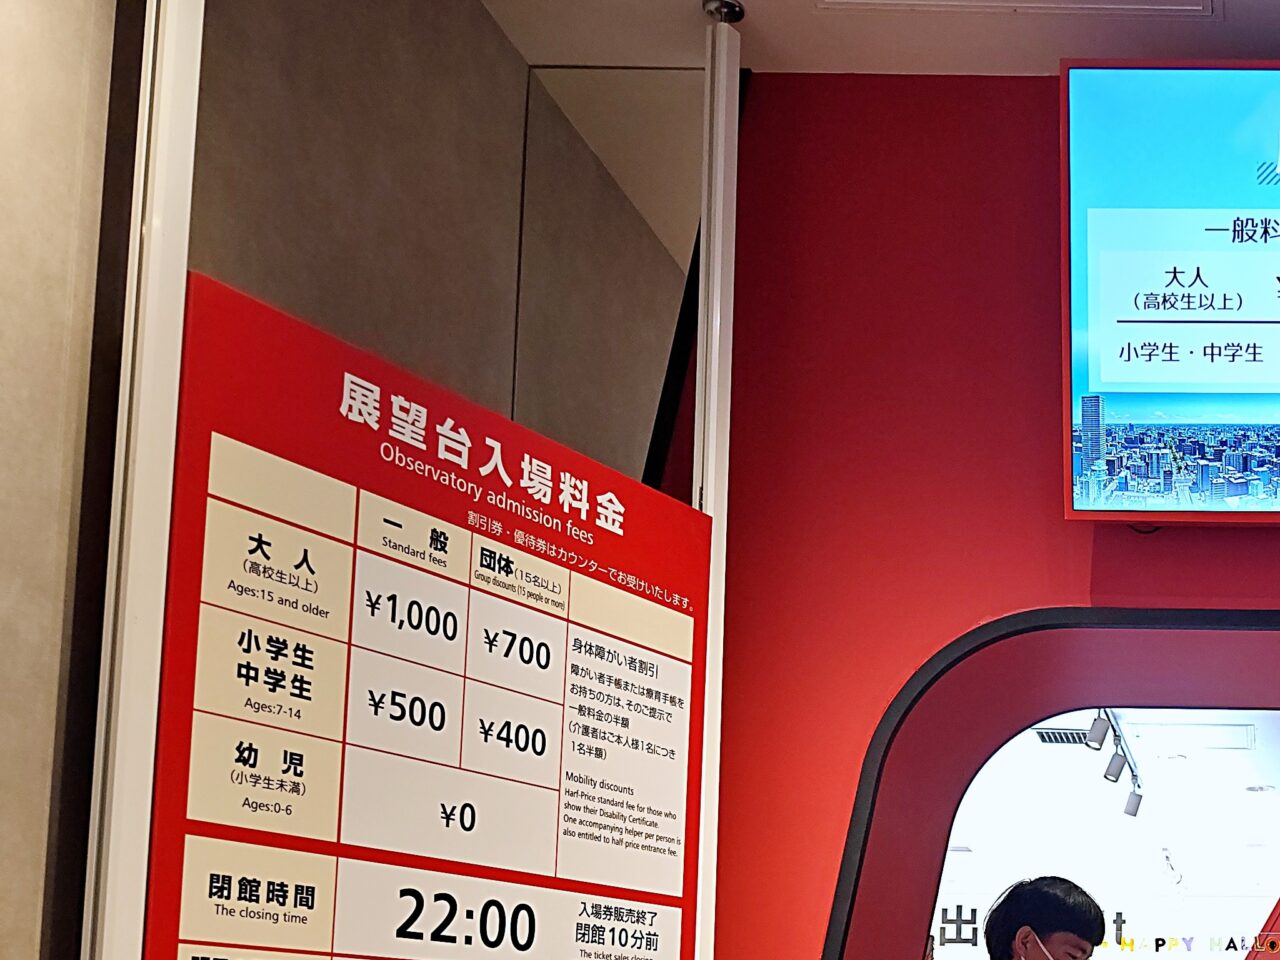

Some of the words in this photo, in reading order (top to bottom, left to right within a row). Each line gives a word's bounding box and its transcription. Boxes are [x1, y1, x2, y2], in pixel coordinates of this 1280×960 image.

[1164, 266, 1209, 289] 大人
[1119, 342, 1264, 363] 小学生・中学生
[339, 371, 625, 536] 展望台入場料金
[379, 441, 483, 502] Observatory
[487, 486, 562, 532] admission
[566, 519, 594, 546] fees
[248, 533, 316, 574] 大人
[382, 517, 449, 554] 一般
[382, 536, 426, 560] Standard
[428, 552, 448, 568] fees
[228, 580, 274, 602] Ages:15
[278, 594, 298, 609] and
[302, 602, 330, 619] older
[365, 590, 458, 641] ¥1,000
[483, 629, 550, 669] ¥700
[238, 629, 314, 670] 小学生
[572, 638, 658, 679] 身体障がい者割引
[236, 661, 312, 701] 中学生
[244, 698, 301, 720] Ages:7-14
[368, 690, 445, 731] ¥500
[479, 719, 546, 756] ¥400
[569, 705, 629, 728] 一般料金の半額
[234, 741, 304, 777] 幼児
[566, 771, 597, 789] Mobility
[599, 779, 634, 795] discounts
[242, 798, 292, 815] Ages:0-6
[440, 803, 476, 831] ¥0
[208, 873, 316, 910] 閉館時間
[214, 904, 235, 916] The
[240, 906, 279, 924] closing
[282, 912, 308, 925] time
[395, 888, 536, 951] 22:00
[579, 902, 657, 927] 入場券販売終了
[575, 922, 659, 951] 閉館10分前
[579, 950, 592, 959] The
[592, 951, 612, 960] ticket
